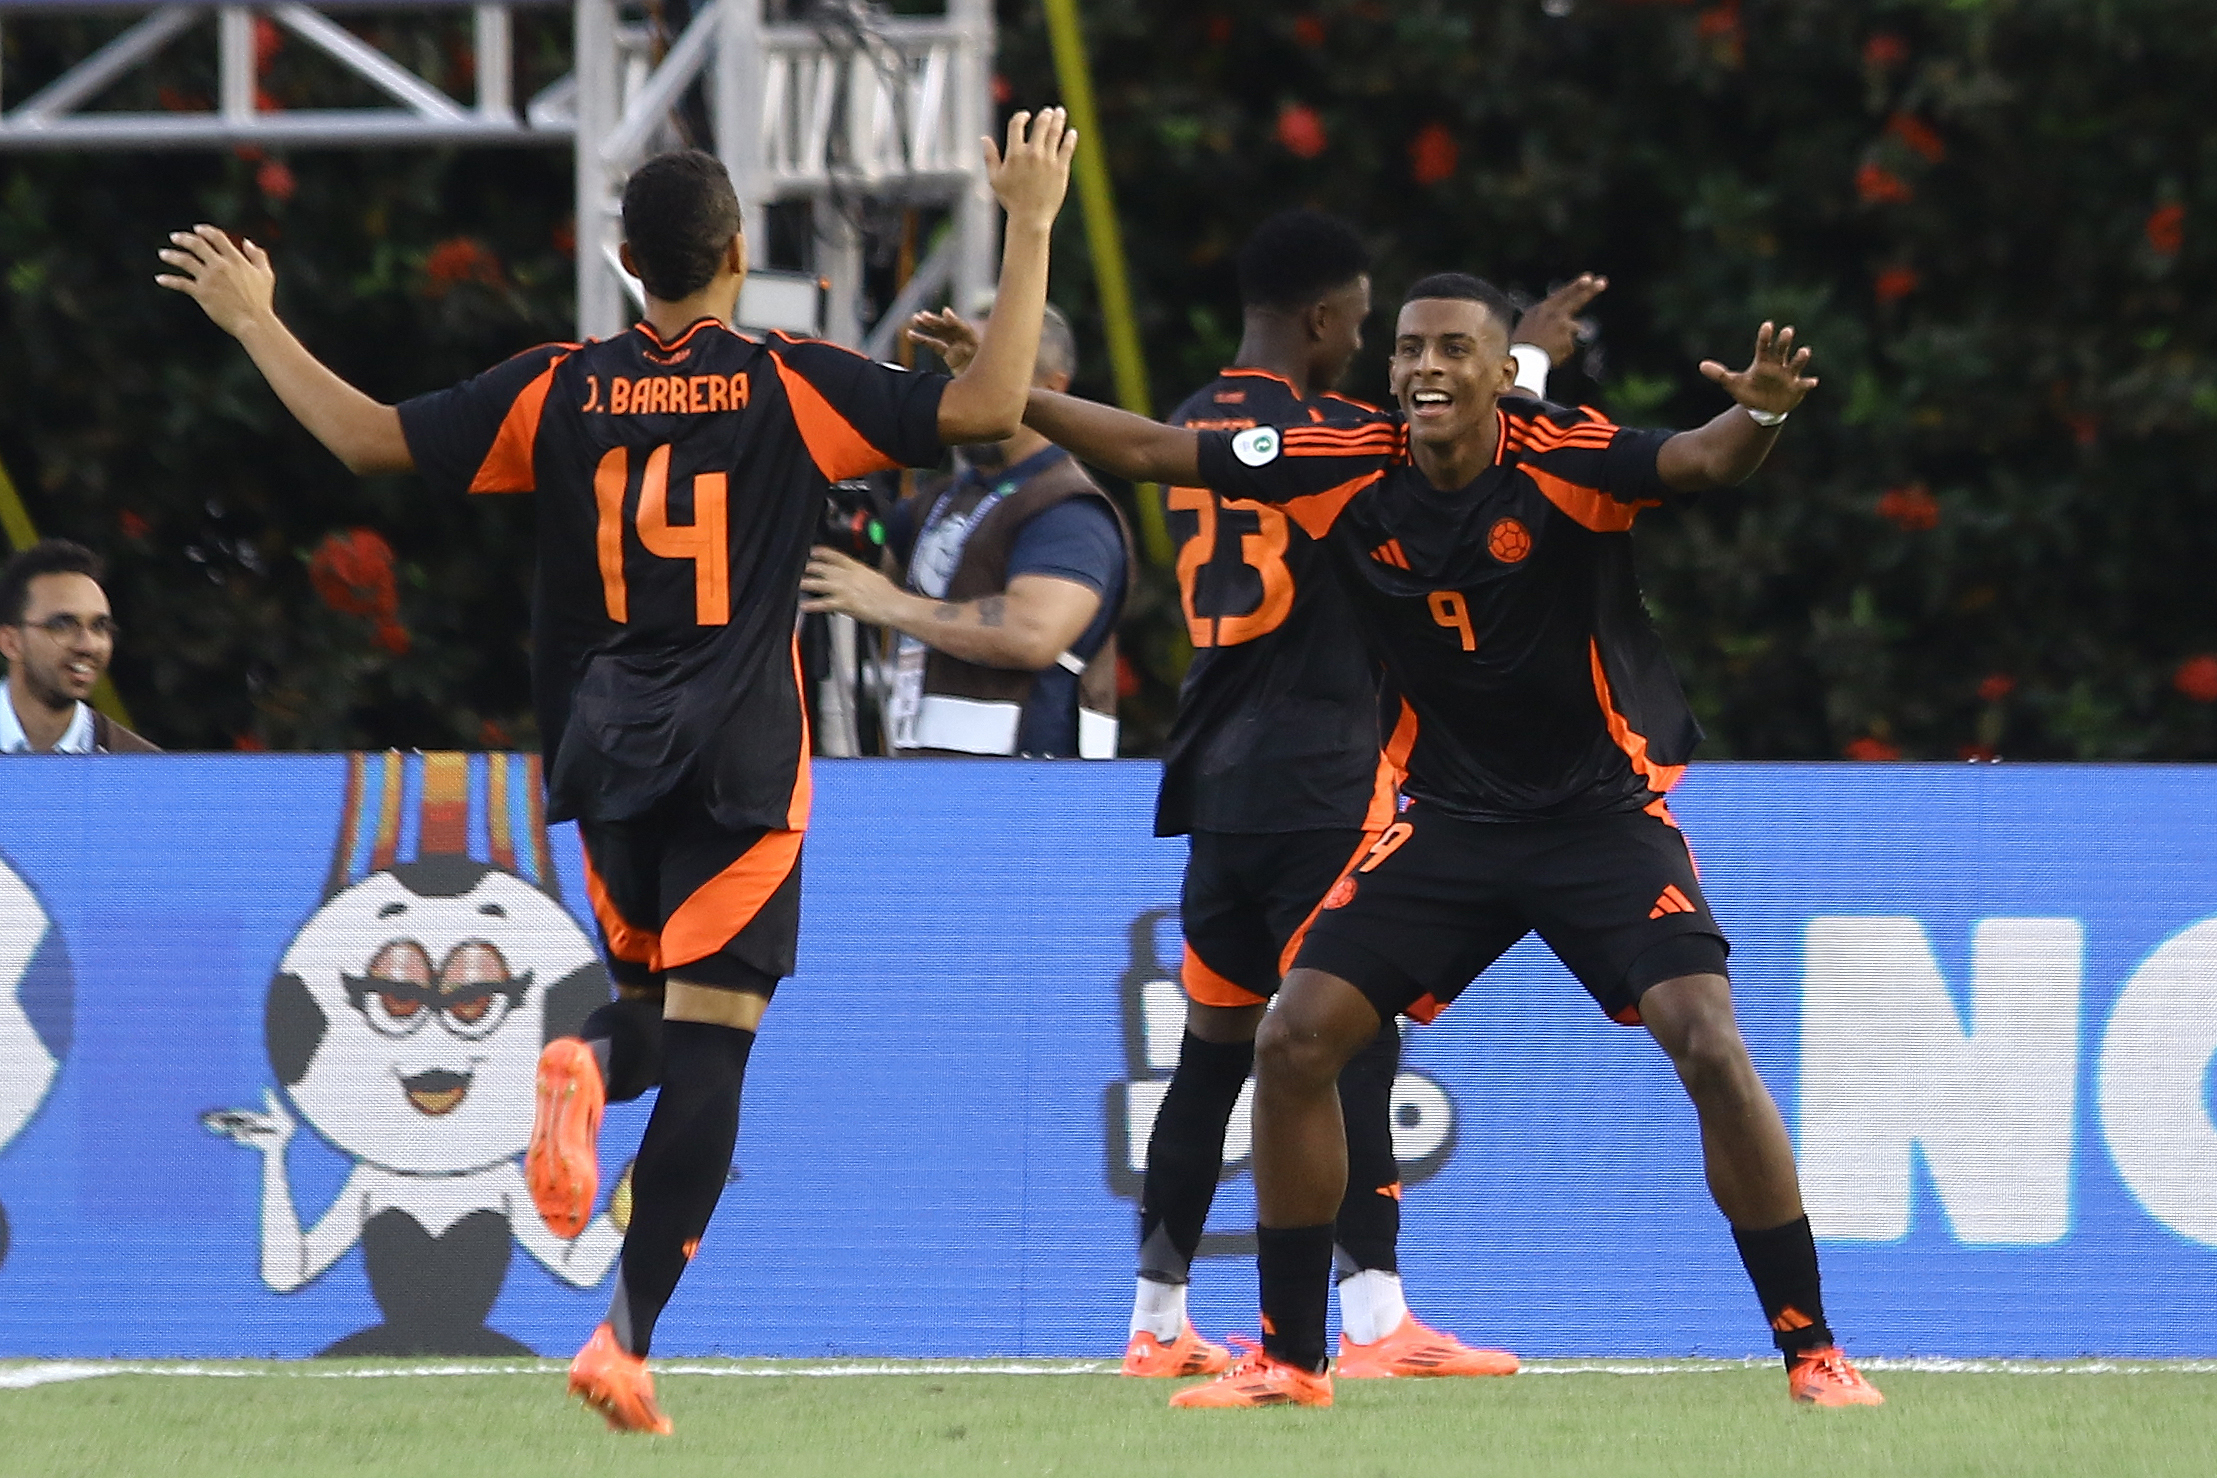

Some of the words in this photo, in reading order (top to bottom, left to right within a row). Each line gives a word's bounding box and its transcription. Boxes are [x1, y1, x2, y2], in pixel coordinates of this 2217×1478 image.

[581, 374, 606, 413] J.
[610, 371, 750, 415] BARRERA
[594, 442, 731, 627] 14
[1166, 485, 1296, 649] 23
[1428, 590, 1476, 652] 9
[1359, 822, 1415, 873] 9
